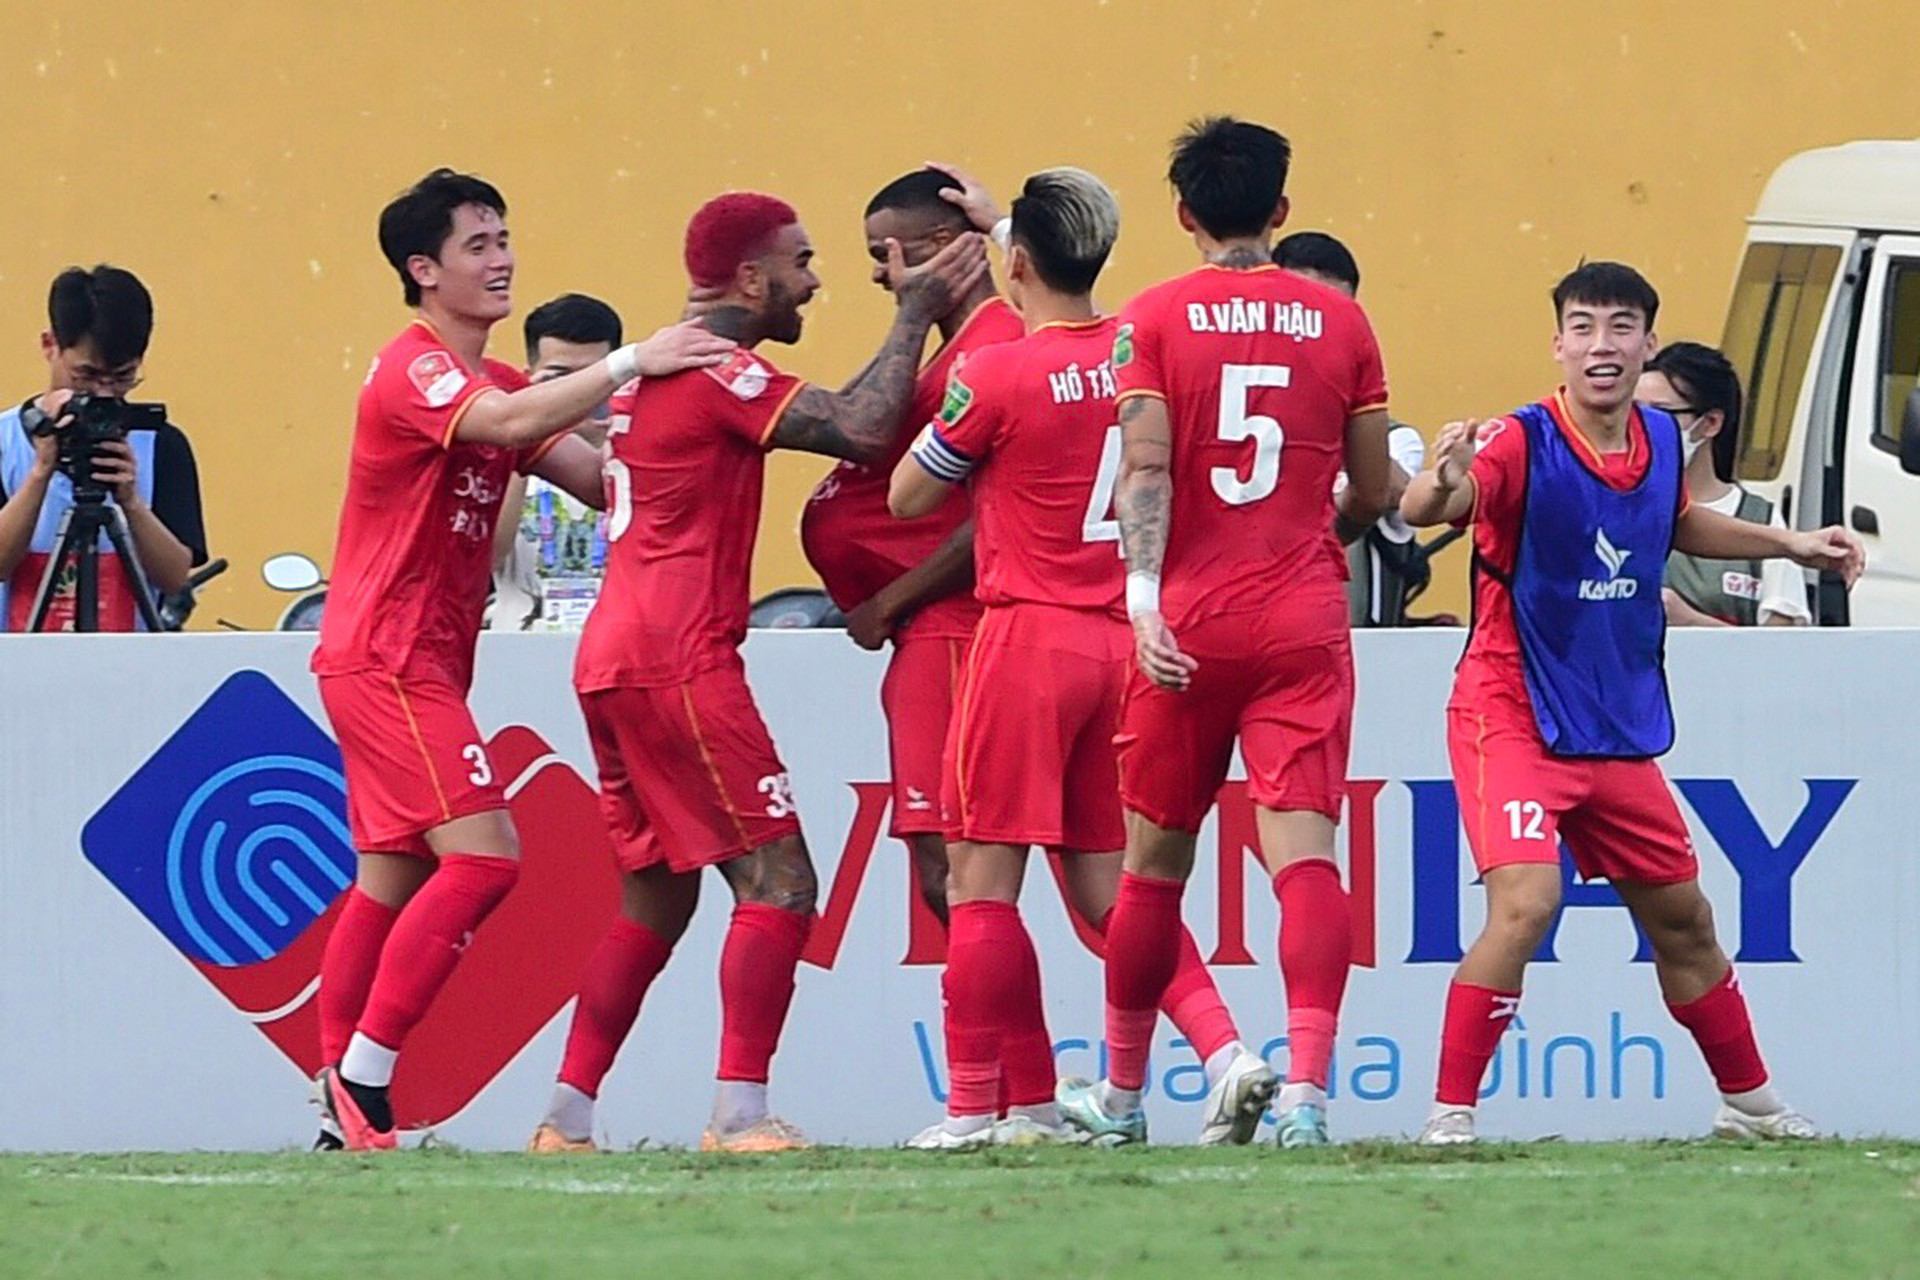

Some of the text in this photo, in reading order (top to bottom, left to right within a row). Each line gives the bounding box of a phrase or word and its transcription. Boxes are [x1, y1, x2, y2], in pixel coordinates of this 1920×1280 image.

[1187, 297, 1323, 342] Đ.VĂN HẬU
[1210, 363, 1291, 505] 5
[1082, 425, 1126, 559] 4
[462, 743, 493, 787] 3
[1502, 801, 1546, 840] 12
